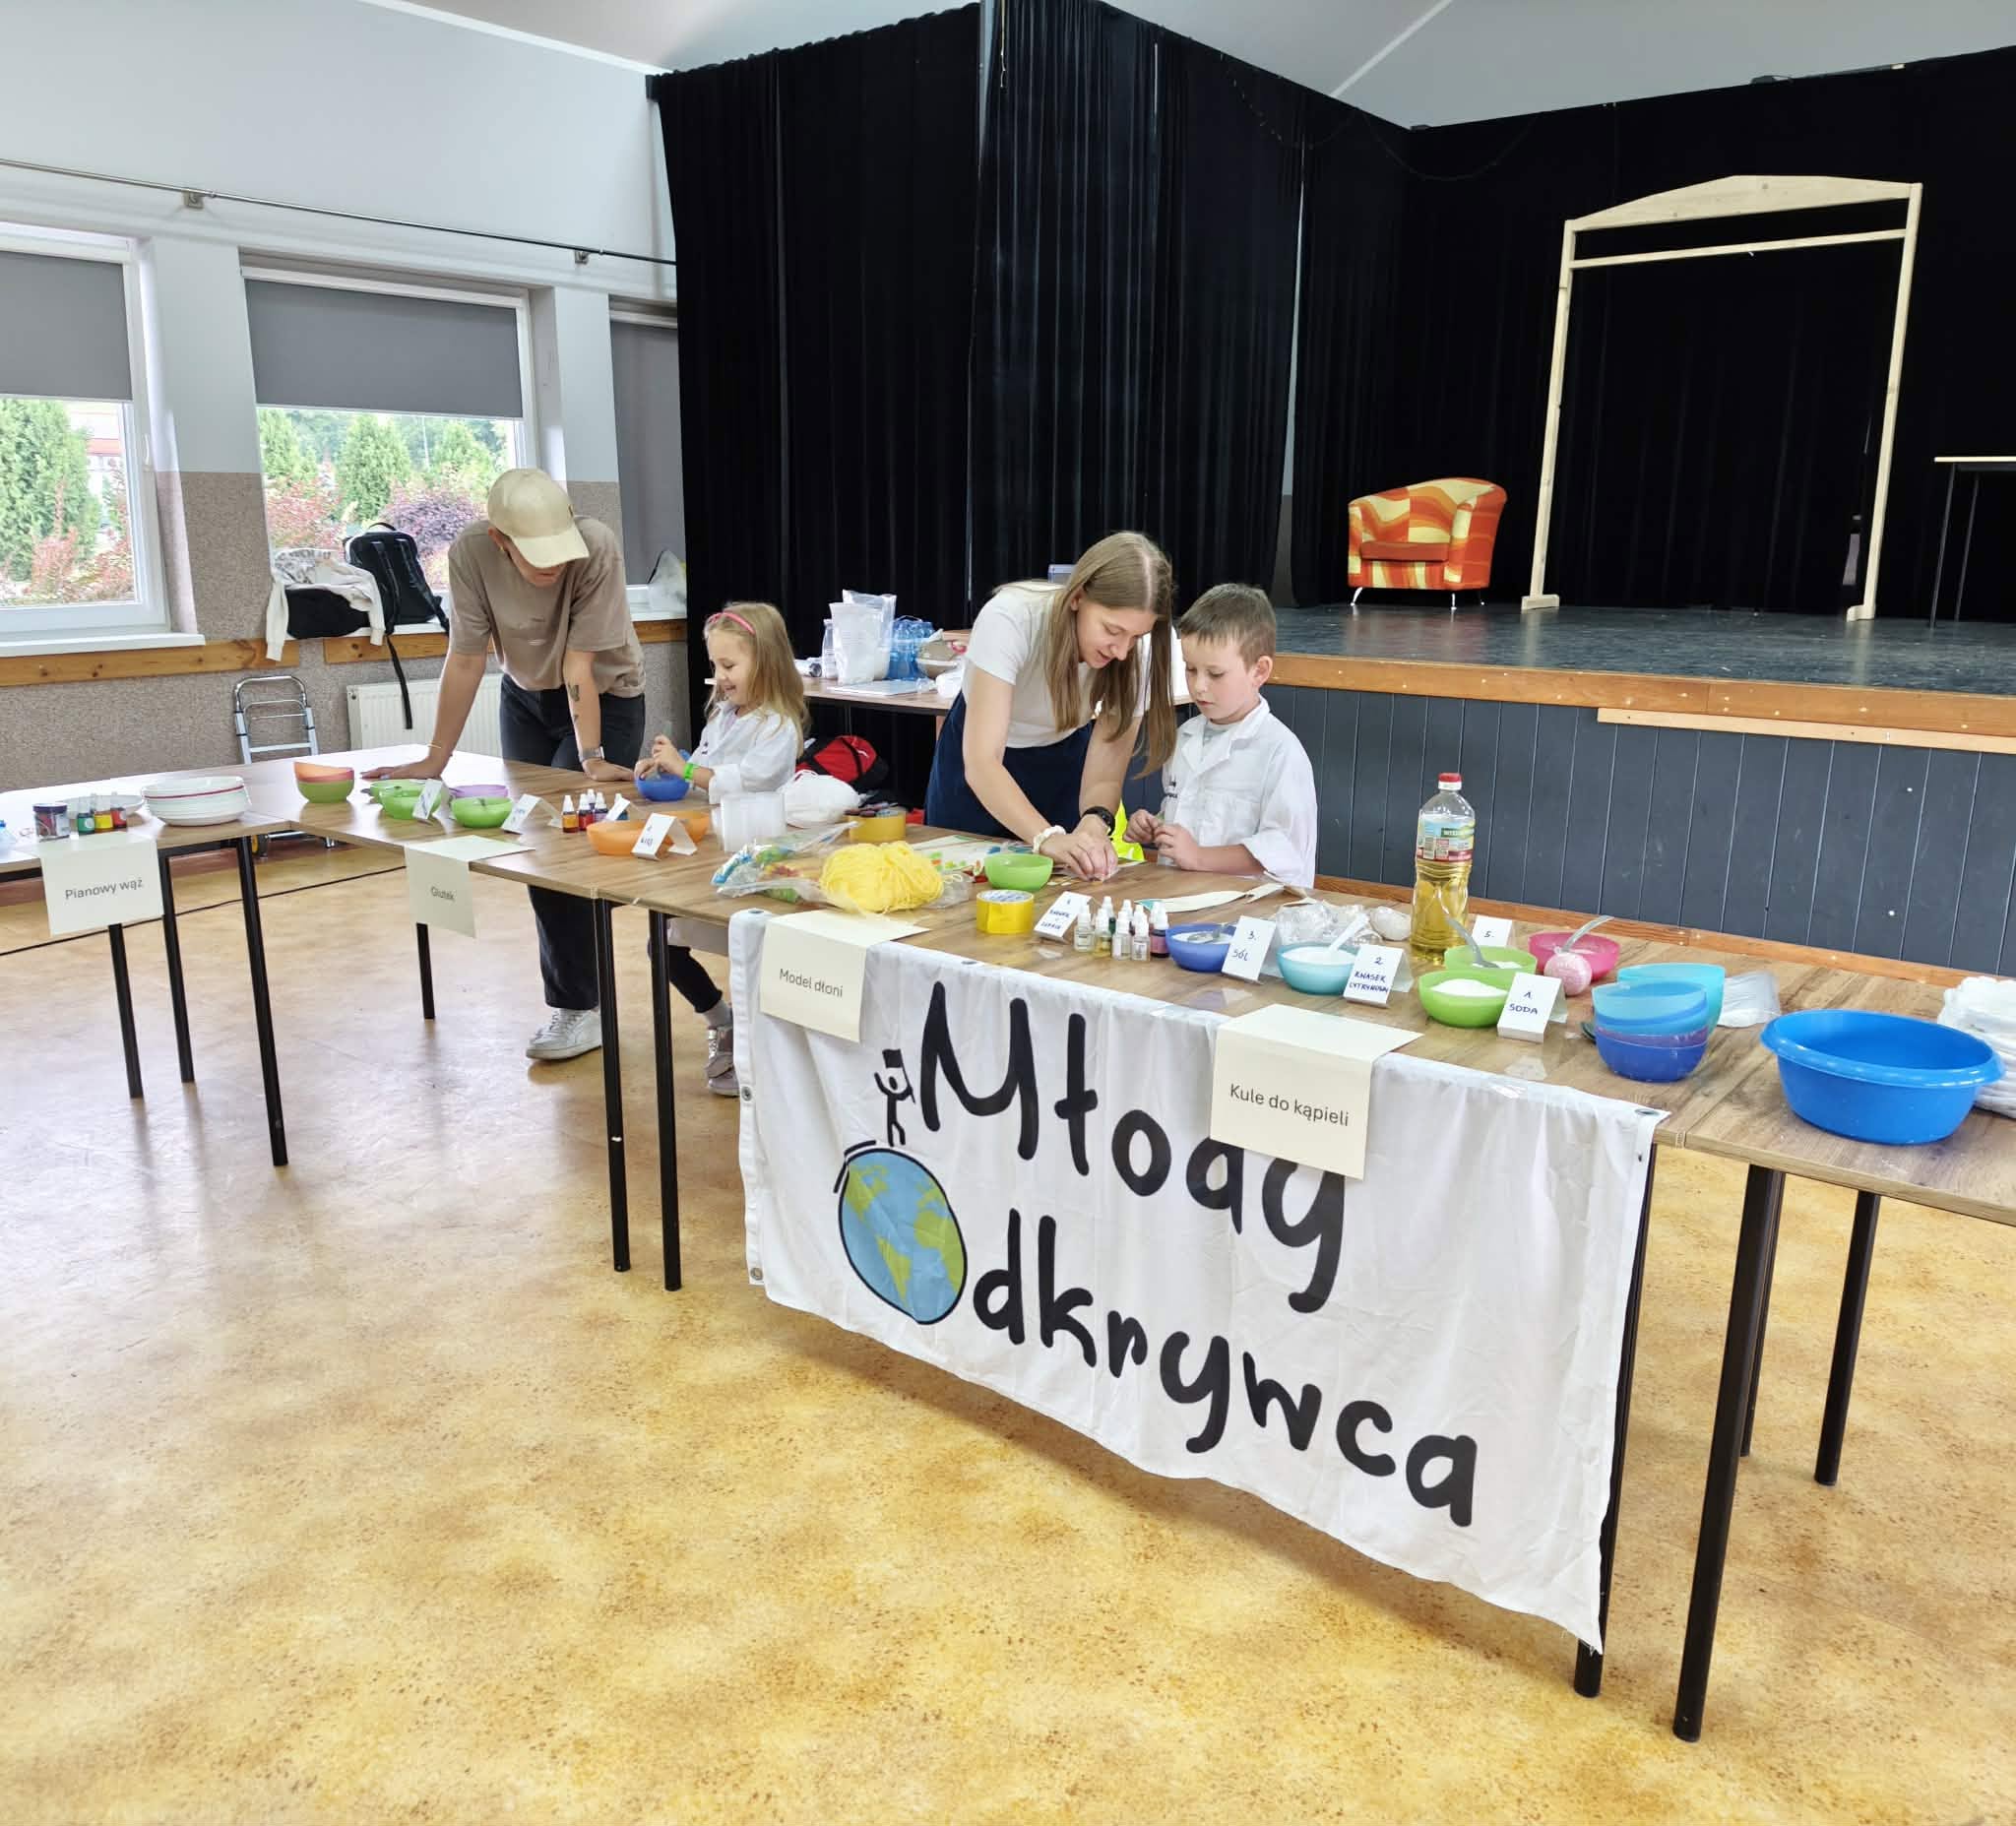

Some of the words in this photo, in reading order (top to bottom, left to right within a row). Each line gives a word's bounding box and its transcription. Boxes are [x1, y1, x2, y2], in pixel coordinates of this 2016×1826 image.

[65, 882, 116, 900] Pianowy
[119, 876, 143, 891] wąż
[779, 968, 813, 989] Model
[814, 979, 844, 998] dłoni
[1354, 970, 1387, 983] KWASEK
[1509, 1003, 1539, 1015] SODA
[1229, 1084, 1265, 1105] Kule
[1268, 1094, 1290, 1111] do
[1293, 1099, 1350, 1127] kąpieli
